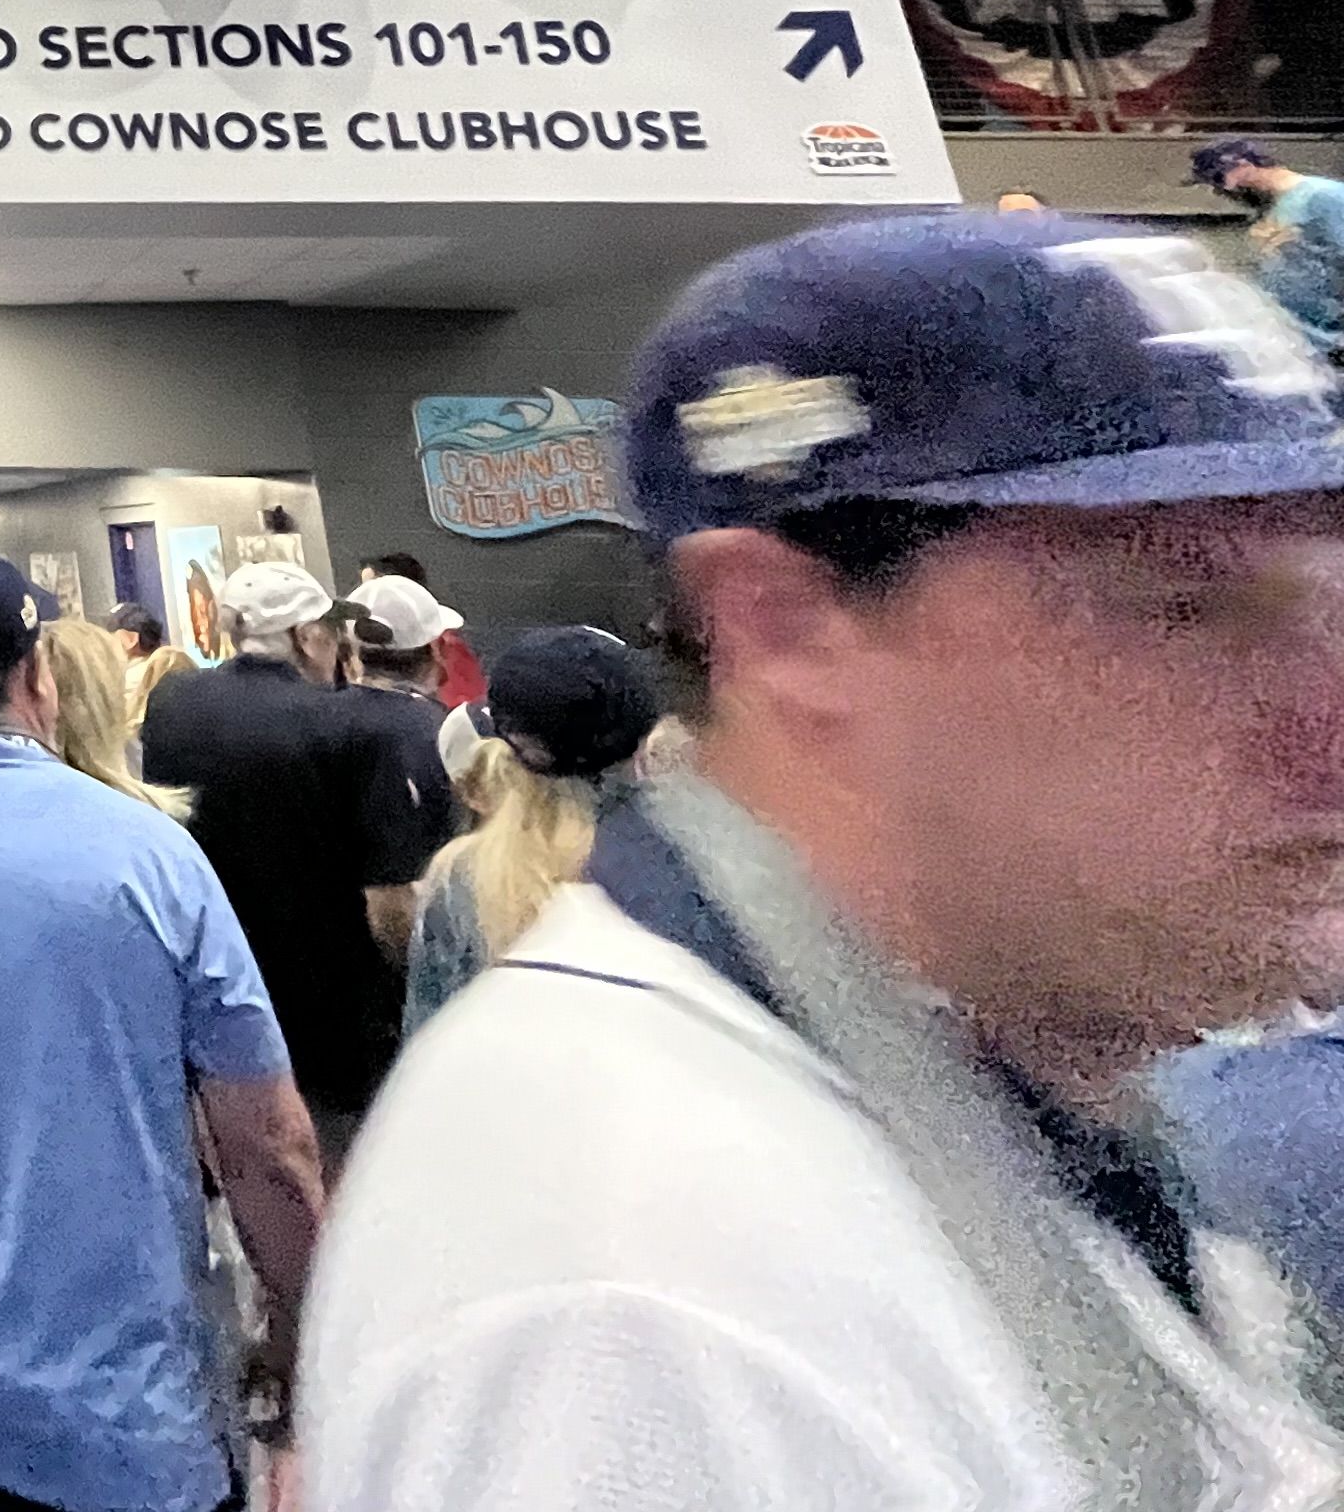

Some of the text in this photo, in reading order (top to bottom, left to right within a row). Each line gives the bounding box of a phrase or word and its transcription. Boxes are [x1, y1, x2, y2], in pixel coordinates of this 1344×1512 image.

[38, 22, 353, 72] SECTIONS
[373, 19, 611, 68] 101-150
[29, 111, 328, 153] COWNOSE
[347, 109, 707, 153] CLUBHOUSE
